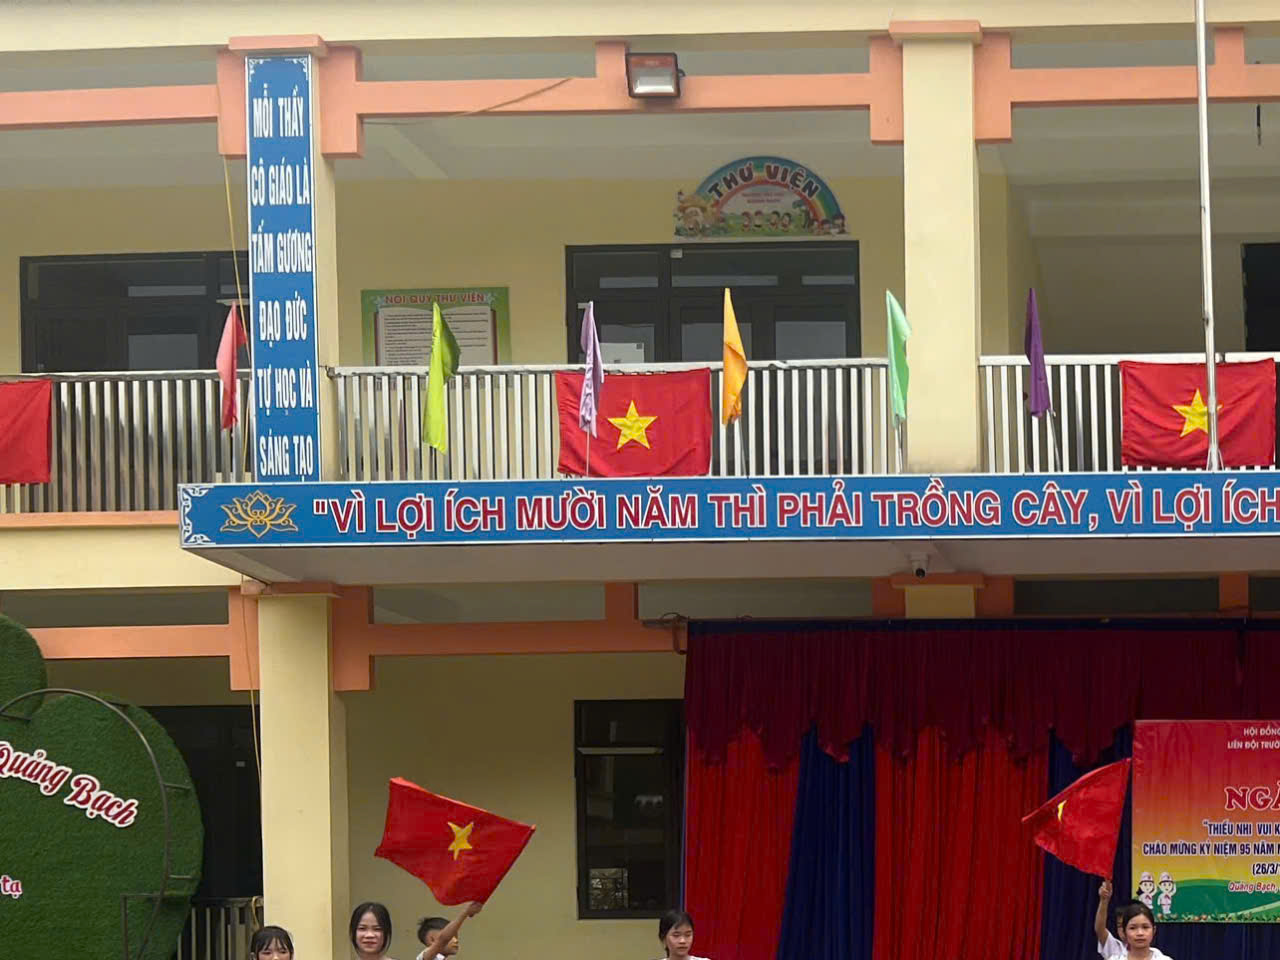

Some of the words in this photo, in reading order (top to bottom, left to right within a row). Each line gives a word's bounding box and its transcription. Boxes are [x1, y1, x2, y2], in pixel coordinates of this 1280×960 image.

[253, 82, 273, 138] MỖI
[251, 157, 265, 206] CÔ
[268, 157, 293, 206] GIÁO
[296, 157, 310, 205] LÀ
[707, 162, 754, 199] THƯ
[765, 164, 820, 199] VIỆN
[252, 219, 274, 273] TẤM
[276, 229, 312, 273] GƯƠNG
[259, 300, 281, 348] ĐẠO
[285, 291, 307, 341] ĐỨC
[257, 364, 272, 416] TỰ
[275, 367, 296, 415] HỌC
[299, 360, 313, 409] VÀ
[259, 429, 290, 477] SÁNG
[293, 435, 313, 483] TẠO
[313, 488, 366, 533] "VÌ
[375, 493, 434, 539] LỢI
[444, 488, 506, 532] ÍCH
[516, 485, 606, 531] MƯỜI
[616, 485, 698, 530] NĂM
[708, 483, 767, 528] THÌ
[776, 479, 863, 528] PHẢI
[871, 477, 1002, 527] TRỒNG
[1012, 480, 1099, 532] CÂY,
[1106, 480, 1144, 525] VÌ
[1152, 484, 1212, 531] LỢI
[1244, 726, 1258, 738] HỘI
[64, 774, 139, 828] Bạch
[1143, 840, 1167, 856] CHÀO
[1170, 840, 1197, 856] MỪNG
[1214, 841, 1237, 858] NIỆM
[1240, 843, 1251, 856] 95
[1254, 840, 1275, 856] NĂM
[1236, 822, 1252, 836] NHI
[1256, 822, 1272, 836] VUI
[1228, 881, 1254, 893] Quảng
